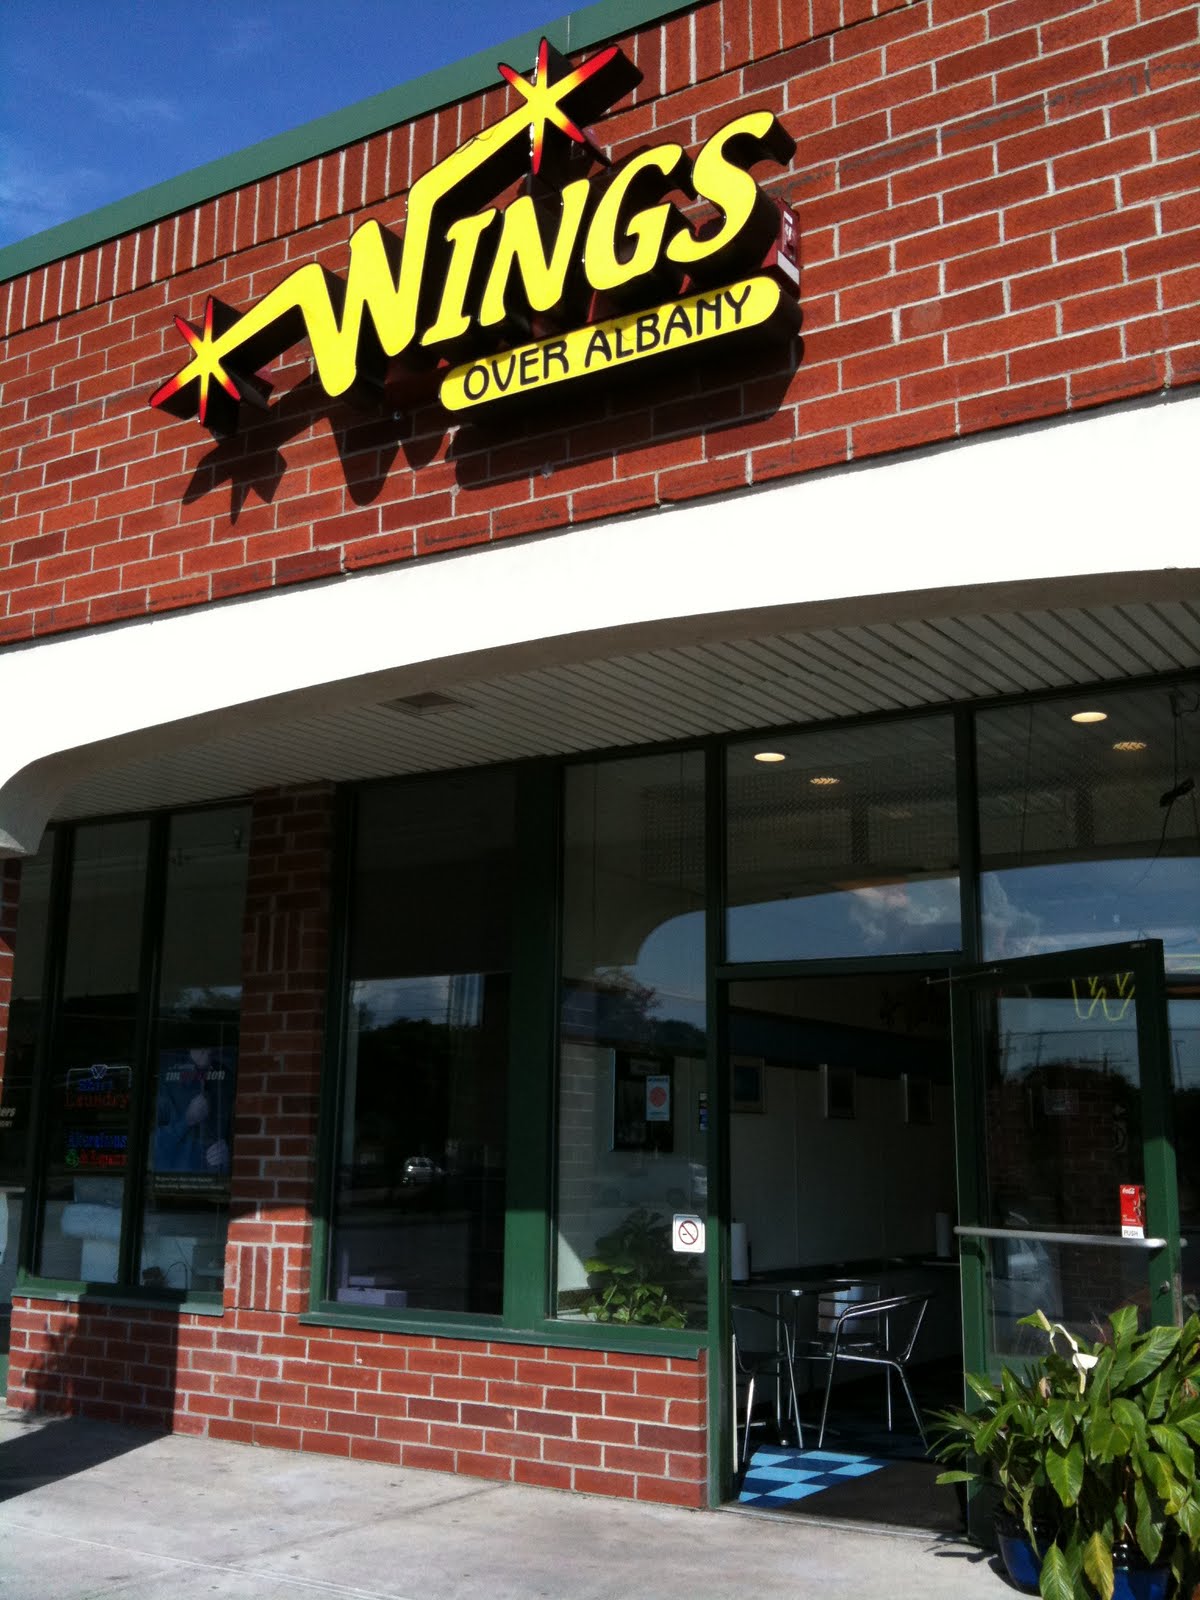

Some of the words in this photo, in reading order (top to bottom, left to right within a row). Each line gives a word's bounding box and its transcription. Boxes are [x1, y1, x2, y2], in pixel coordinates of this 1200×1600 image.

[190, 70, 775, 400] WINGS
[463, 341, 570, 401] OVER
[584, 284, 752, 368] ALBANY
[1123, 1229, 1139, 1237] PUSH
